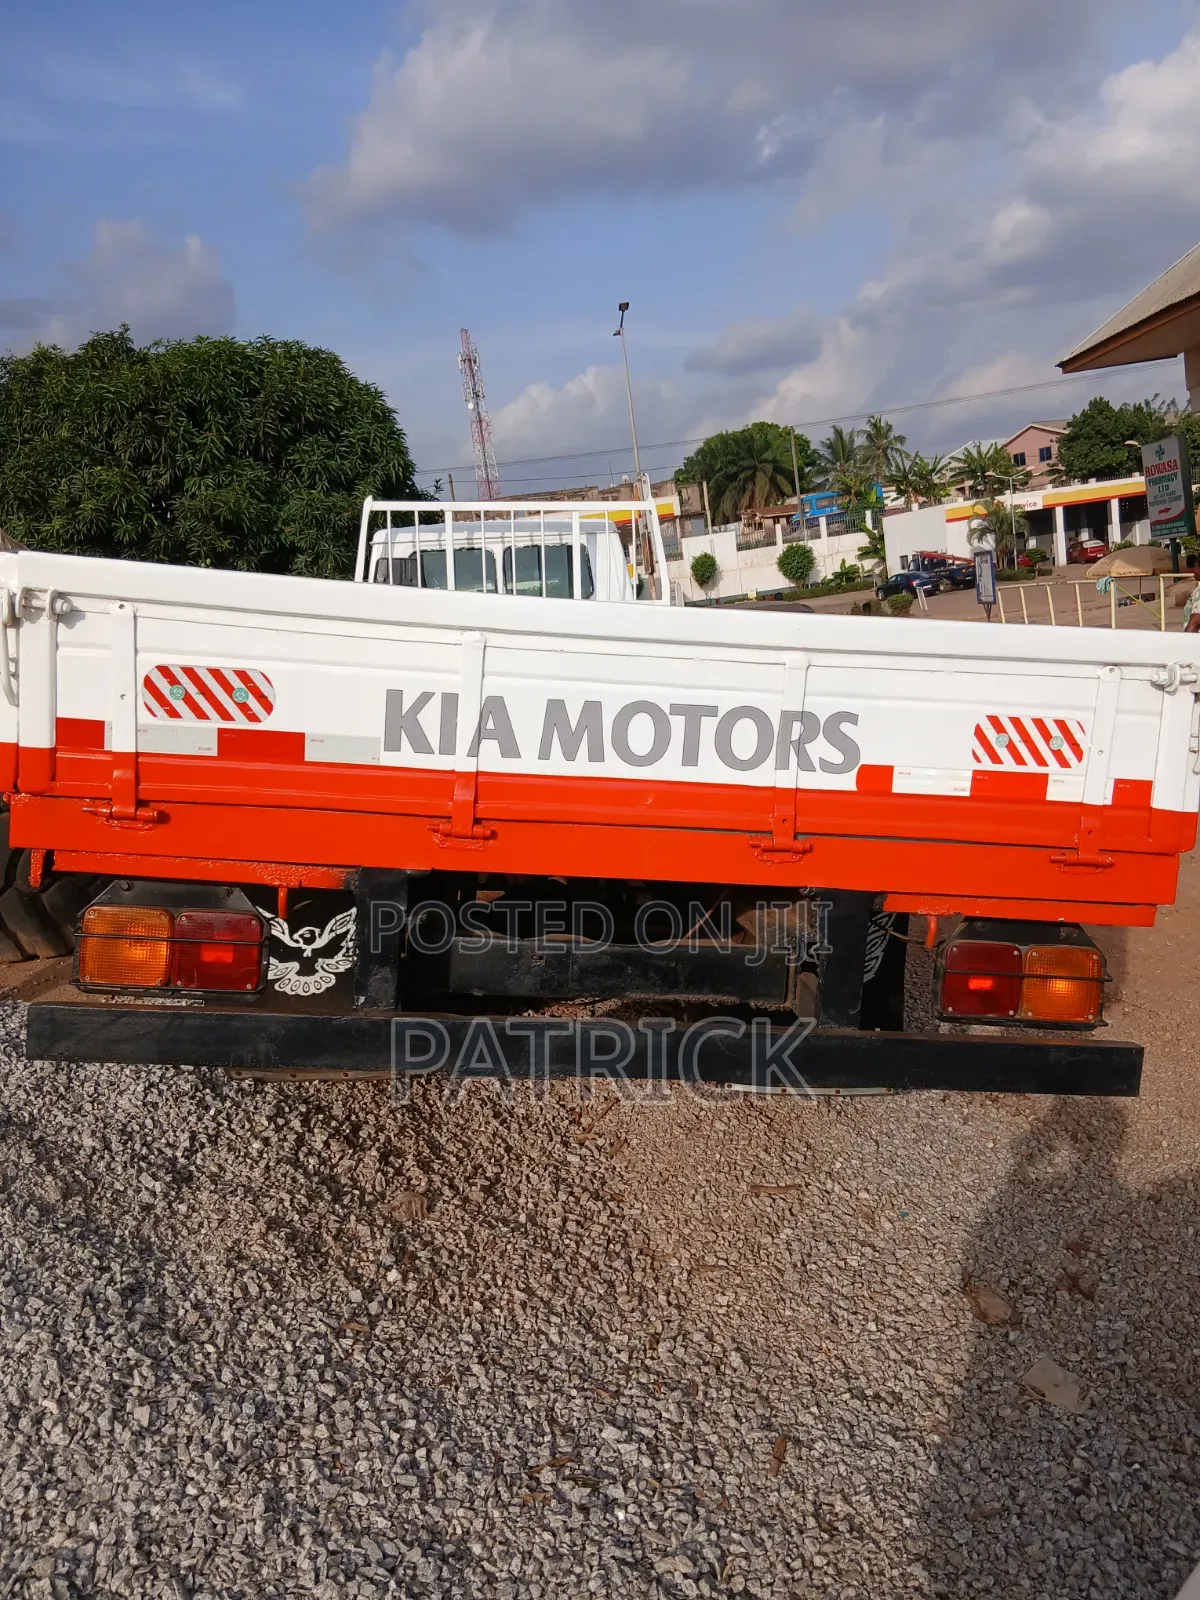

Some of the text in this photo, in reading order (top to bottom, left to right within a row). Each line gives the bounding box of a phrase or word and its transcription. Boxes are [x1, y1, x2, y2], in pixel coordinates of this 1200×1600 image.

[1144, 459, 1179, 478] ROWASA
[1158, 484, 1170, 494] LTD
[383, 688, 861, 774] KIA MOTORS
